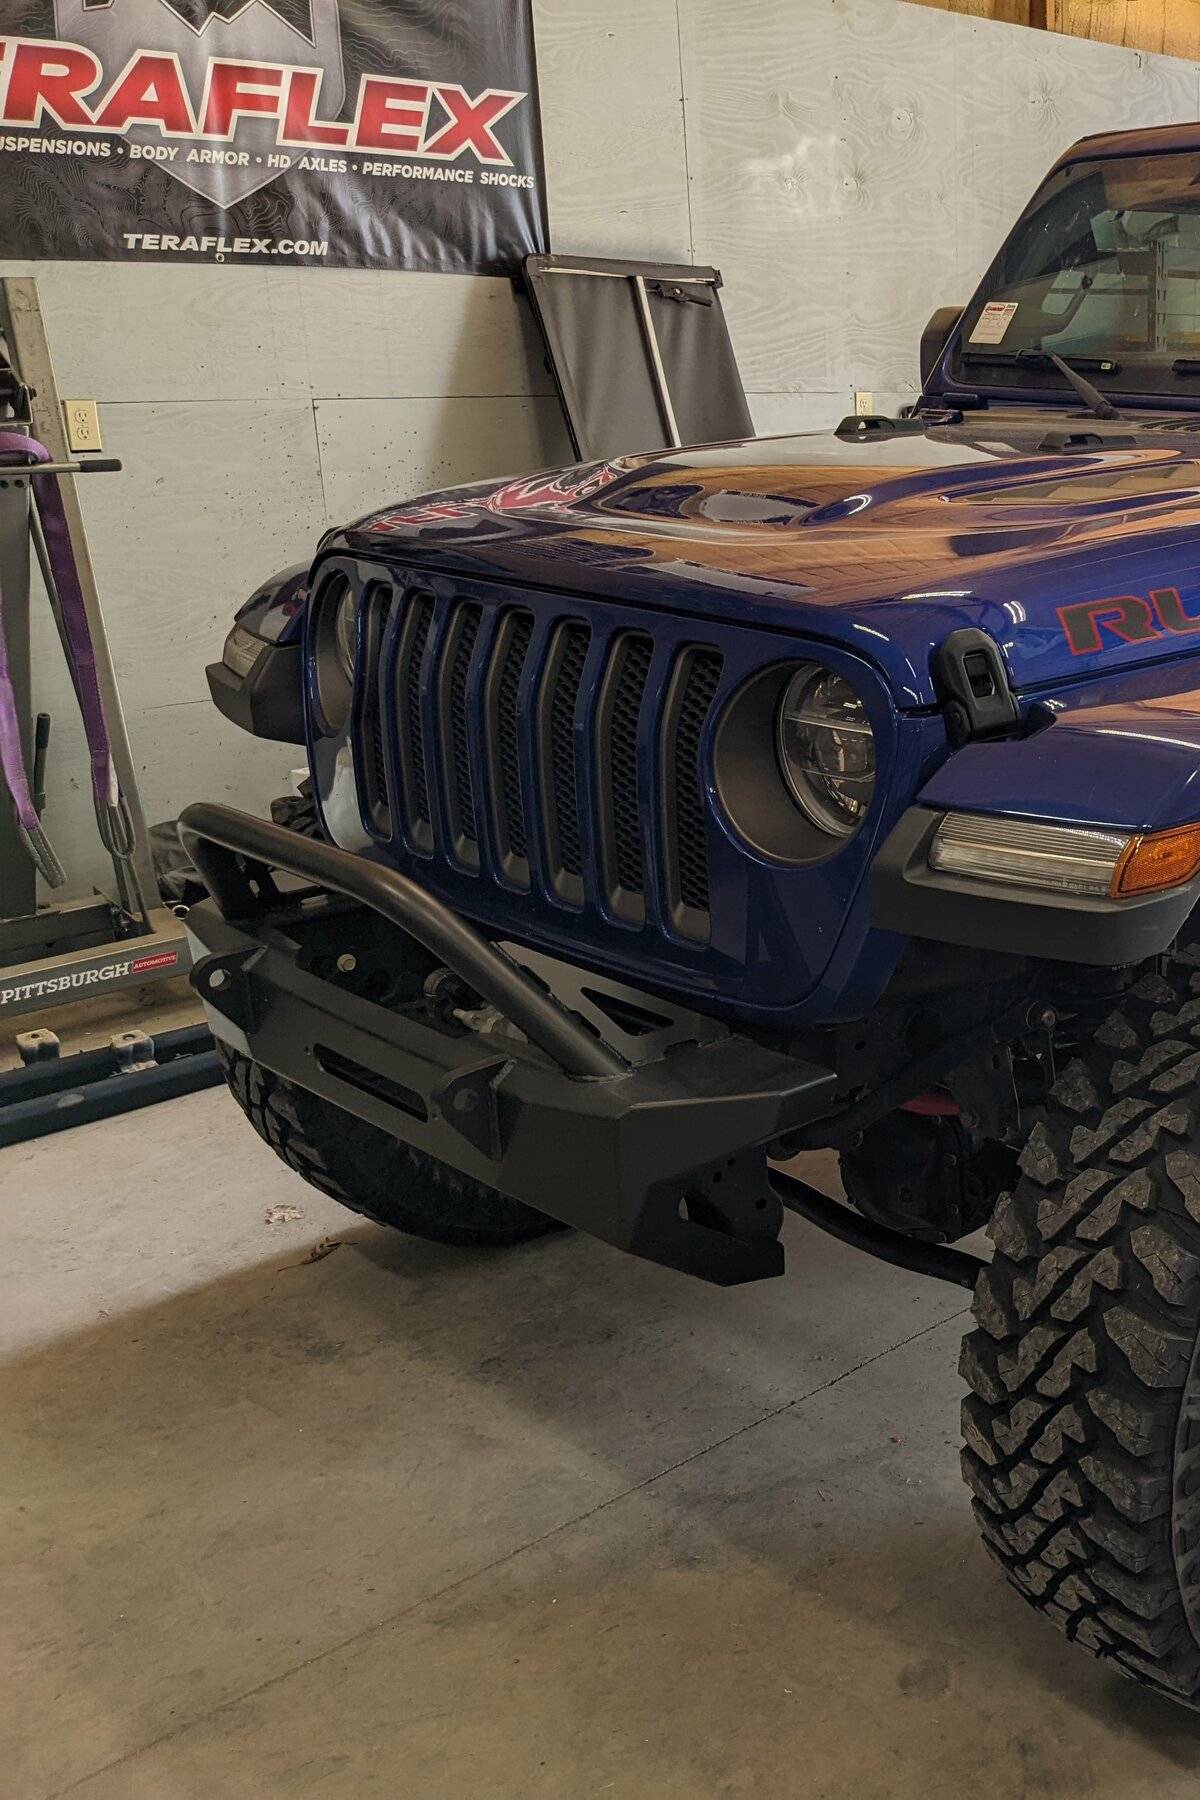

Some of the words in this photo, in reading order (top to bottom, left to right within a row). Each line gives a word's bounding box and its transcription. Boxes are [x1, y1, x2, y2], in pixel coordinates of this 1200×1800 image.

[0, 36, 528, 167] RAFLEX
[130, 144, 180, 161] BODY
[186, 148, 250, 166] ARMOR
[267, 154, 291, 169] HD
[298, 156, 347, 173] AXLES
[363, 162, 474, 184] PERFORMANCE
[480, 172, 535, 189] SHOCKS
[123, 233, 329, 256] TERAFLEX.COM
[1, 962, 131, 1004] PITTSBURGH
